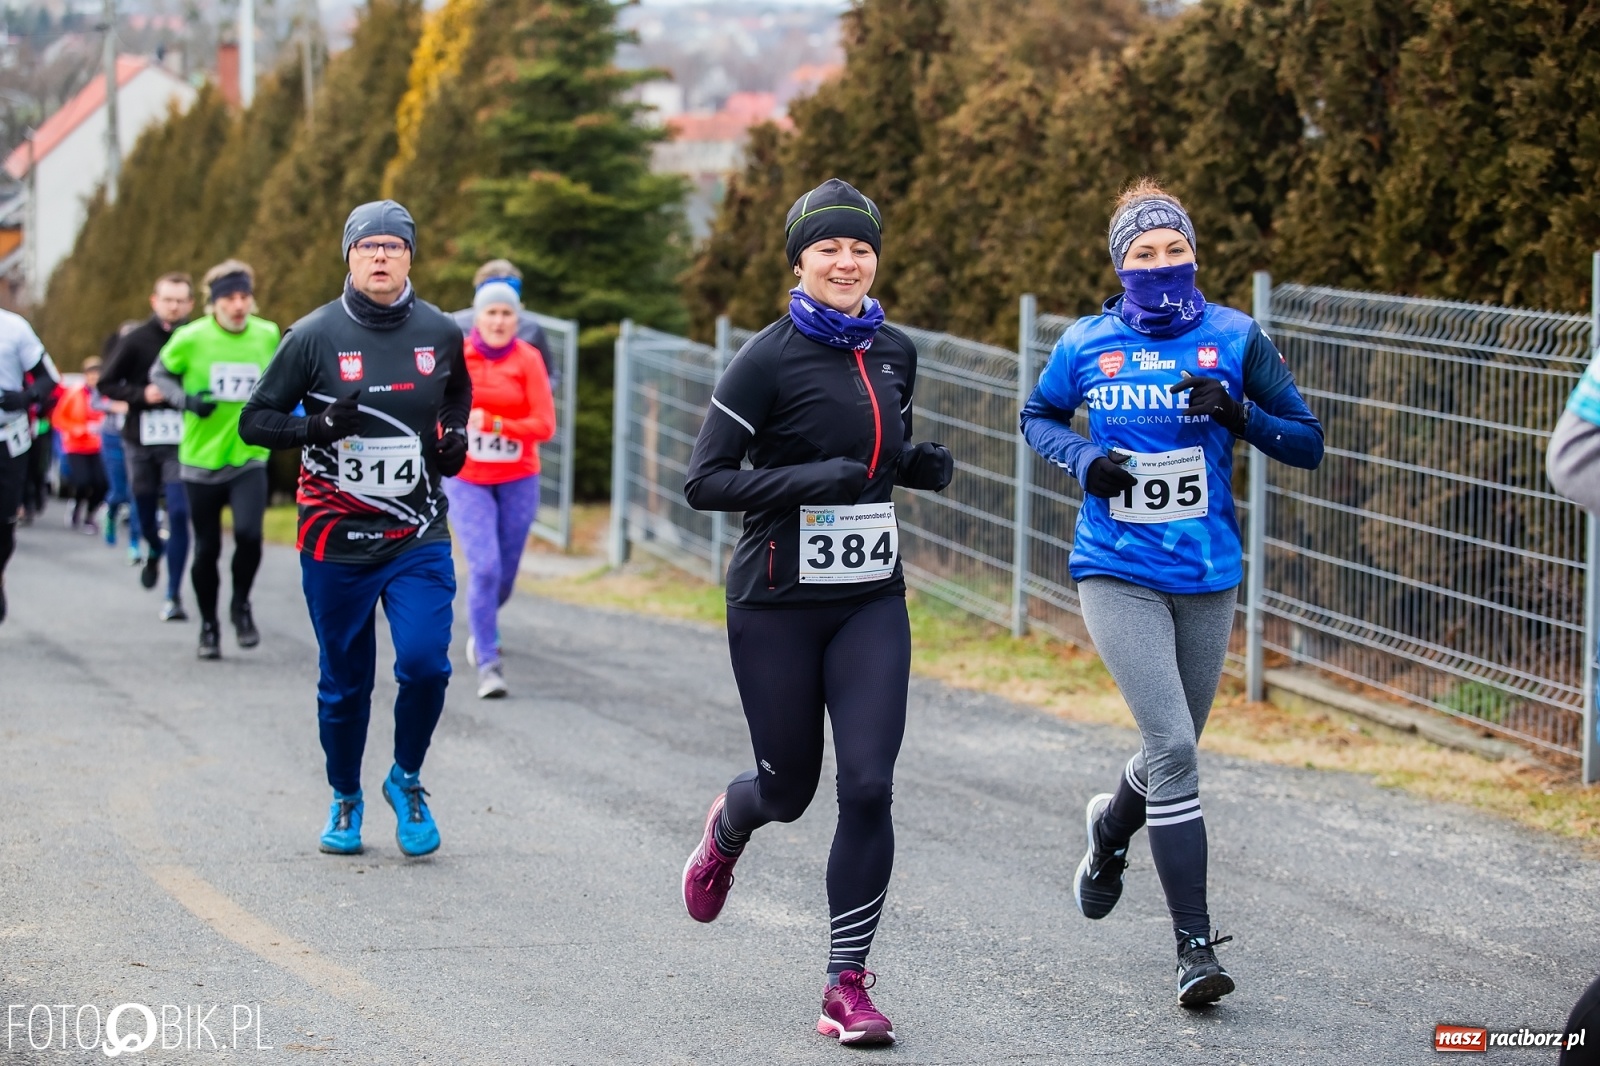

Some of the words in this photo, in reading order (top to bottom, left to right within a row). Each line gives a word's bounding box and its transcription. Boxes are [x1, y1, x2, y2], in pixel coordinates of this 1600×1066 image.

[217, 376, 256, 392] 177
[1176, 414, 1210, 424] TEAM
[474, 436, 518, 454] 145
[1141, 454, 1202, 468] www.personalbest.pl
[344, 457, 416, 485] 314
[1123, 474, 1202, 510] 195
[839, 511, 893, 521] www.personalbest.pl
[806, 531, 894, 569] 384
